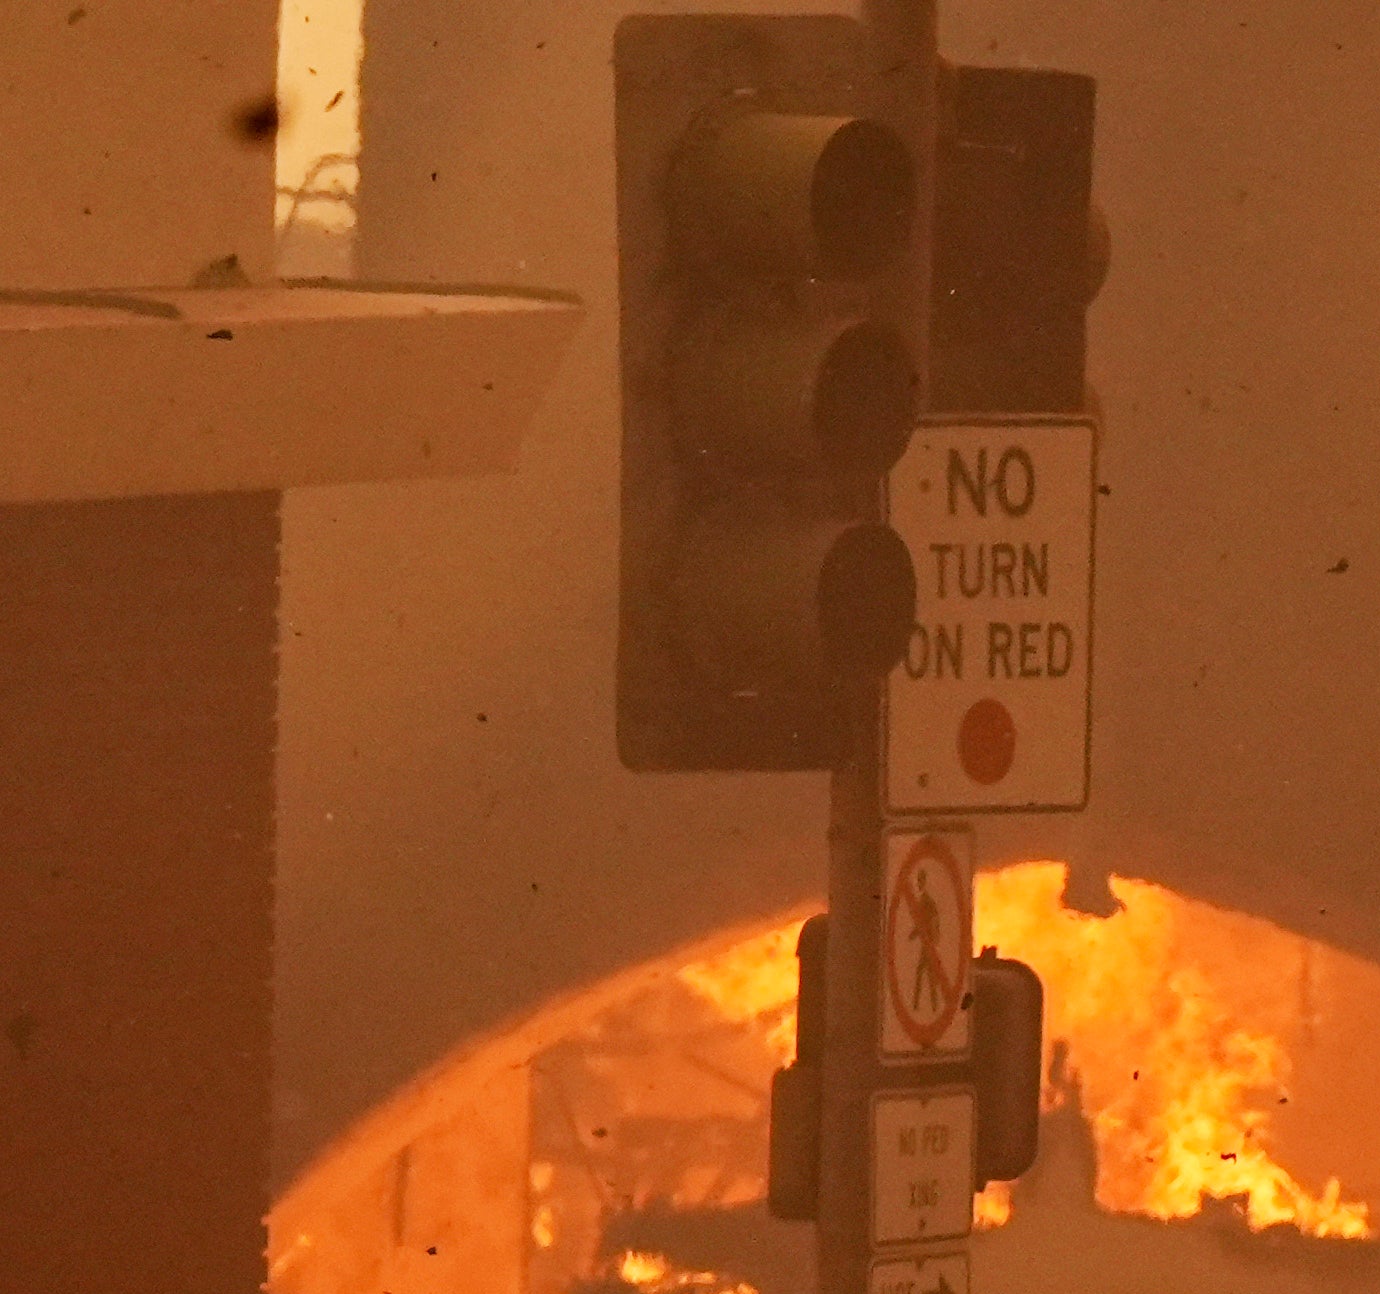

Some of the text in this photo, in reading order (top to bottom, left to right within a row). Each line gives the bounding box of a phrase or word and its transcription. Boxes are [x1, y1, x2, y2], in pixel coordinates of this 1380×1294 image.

[945, 446, 1036, 518] NO
[929, 543, 1049, 599] TURN
[903, 619, 1075, 681] ON RED
